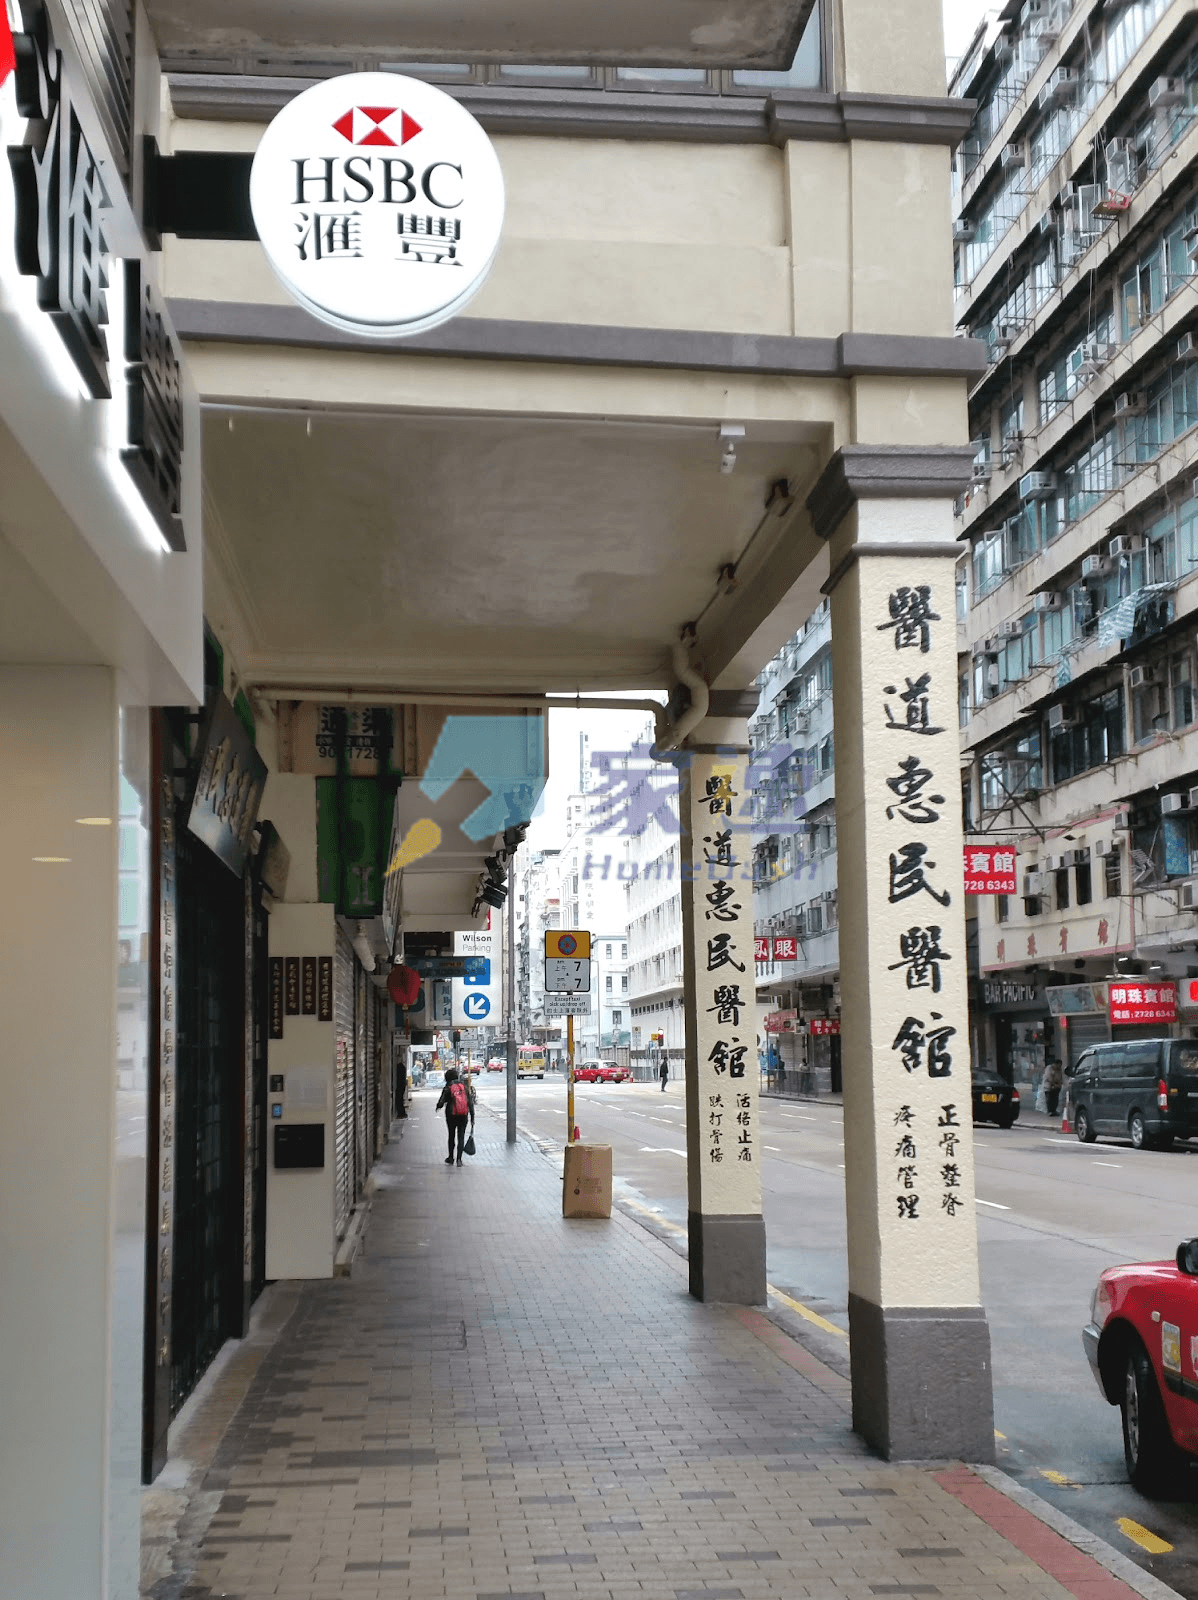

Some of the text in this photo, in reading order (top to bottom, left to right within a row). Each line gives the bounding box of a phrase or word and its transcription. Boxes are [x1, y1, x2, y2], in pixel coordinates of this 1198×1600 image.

[290, 156, 464, 209] HSBC
[293, 209, 464, 267] 滙豐
[986, 880, 1015, 891] 6343
[462, 934, 492, 942] Wilson
[462, 944, 491, 953] Parking
[573, 961, 582, 972] 7
[574, 978, 582, 989] 7
[984, 984, 1001, 1004] BAR
[1111, 988, 1175, 1004] 明珠賓館
[1155, 1010, 1176, 1018] 6343
[893, 1104, 921, 1220] 疼痛管理
